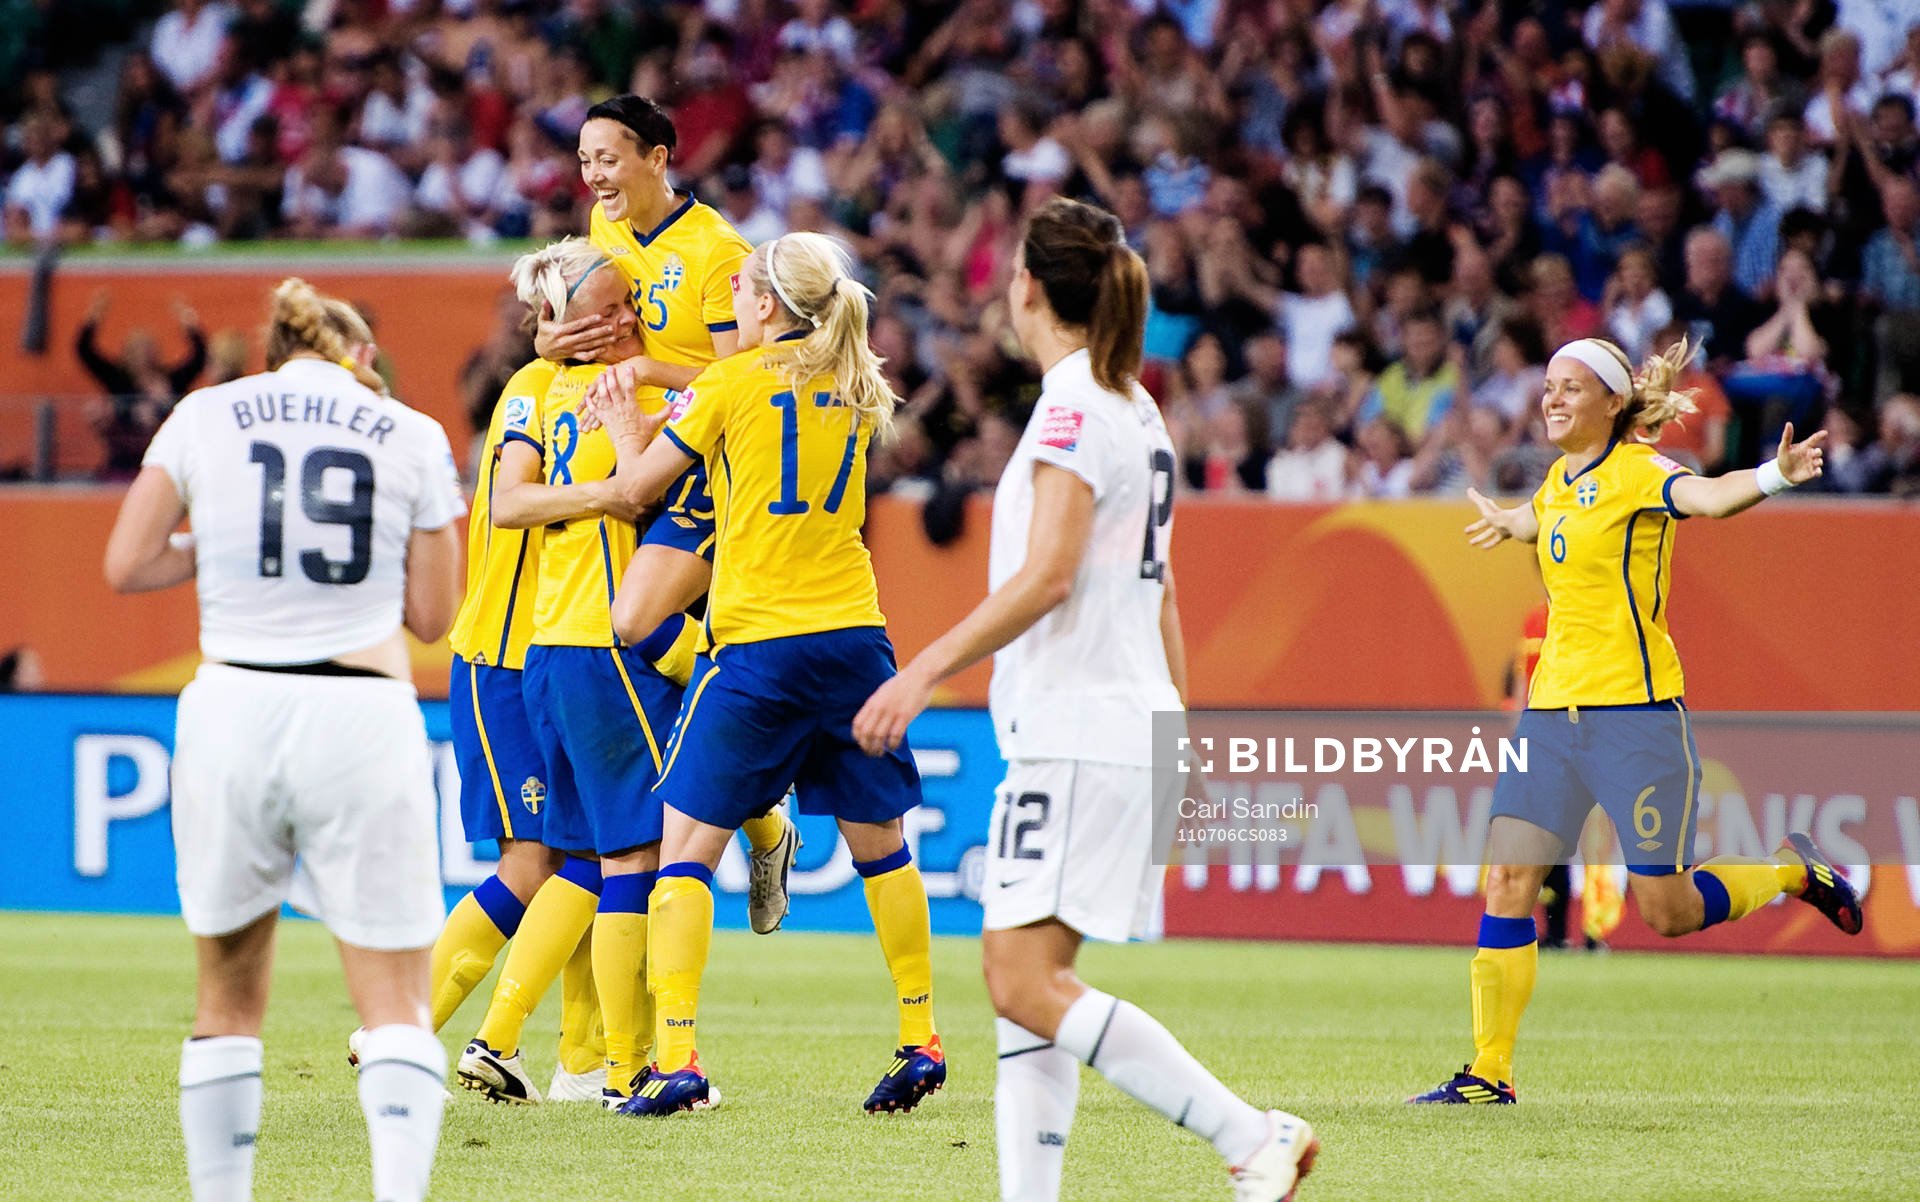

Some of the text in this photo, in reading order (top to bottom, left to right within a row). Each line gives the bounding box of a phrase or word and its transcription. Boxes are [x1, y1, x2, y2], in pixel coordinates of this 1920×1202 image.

[232, 393, 396, 444] BUEHLER
[768, 390, 858, 515] 17
[249, 440, 375, 585] 19
[1550, 514, 1567, 564] 6
[998, 791, 1051, 861] 12
[1632, 785, 1662, 839] 6
